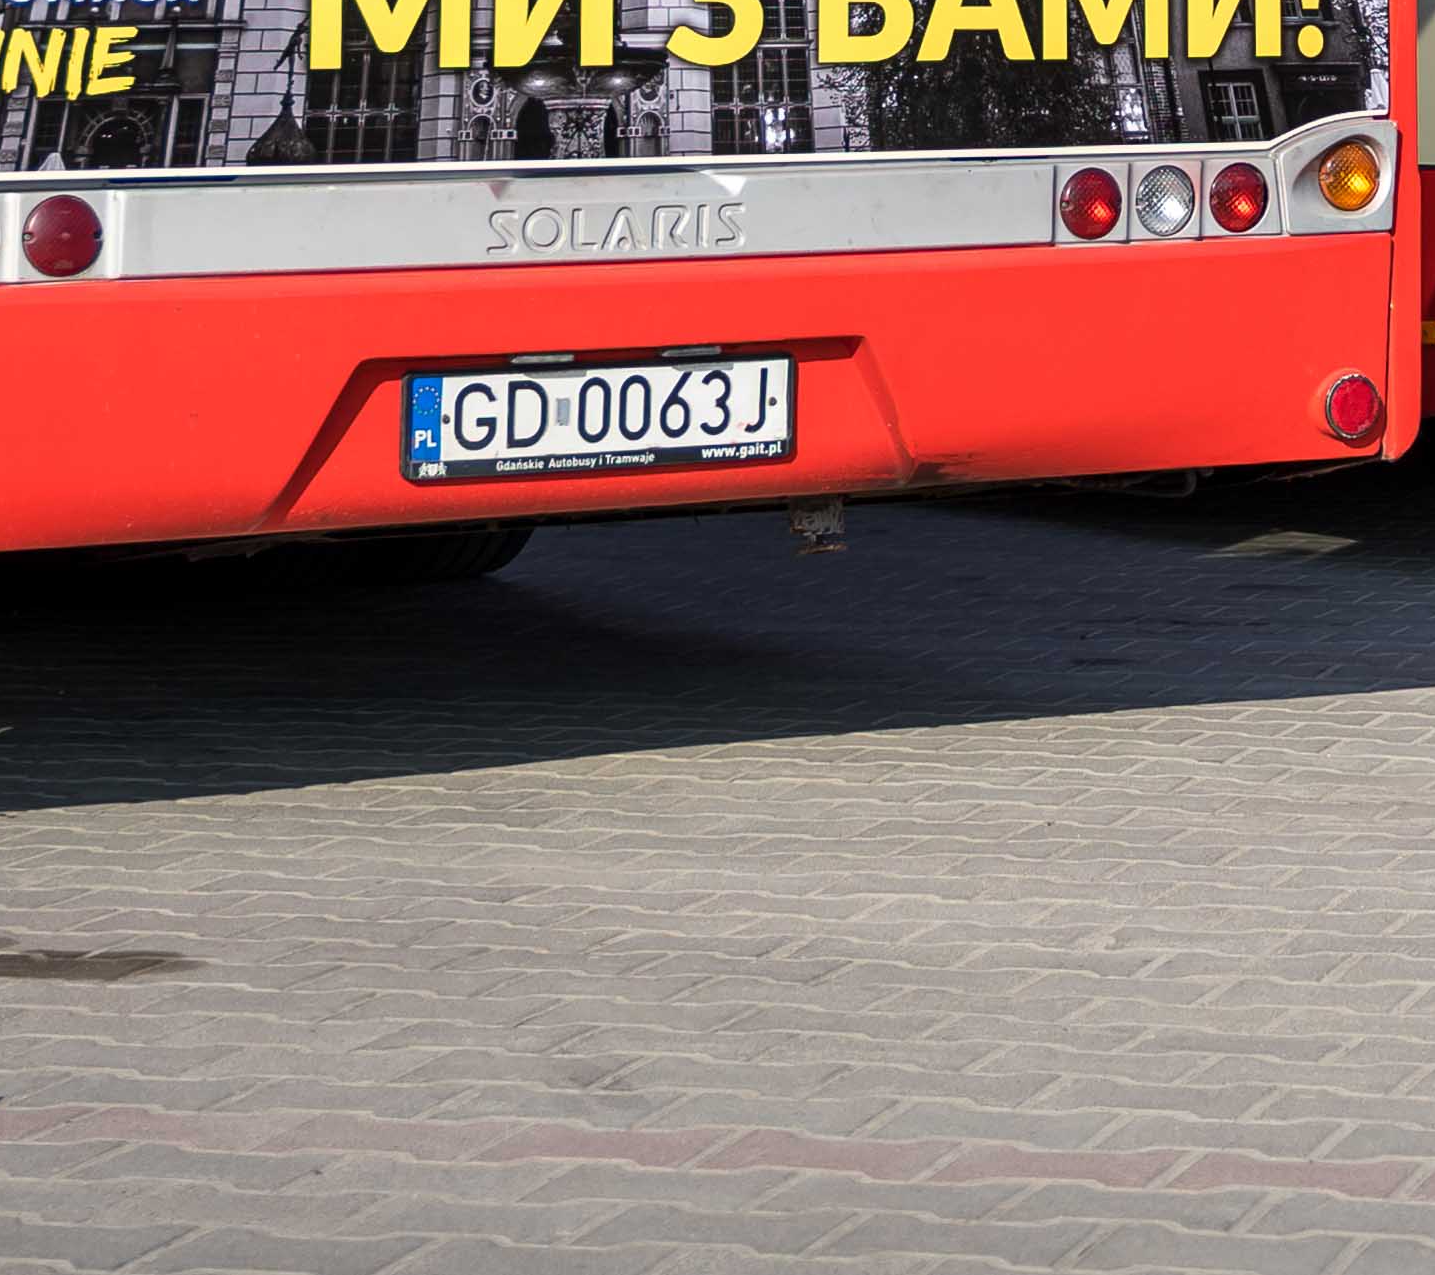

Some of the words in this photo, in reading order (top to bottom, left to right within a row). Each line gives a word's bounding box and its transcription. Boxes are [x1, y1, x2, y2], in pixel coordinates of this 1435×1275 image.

[486, 202, 747, 254] SOLARIS
[453, 379, 549, 451] GD
[577, 366, 769, 444] 0063J
[414, 429, 437, 449] PL
[701, 442, 783, 460] www.gait.pl
[495, 453, 544, 472] Gdańskie
[548, 456, 597, 470] Autobusy
[599, 455, 603, 465] i
[605, 452, 656, 466] Tramwaje
